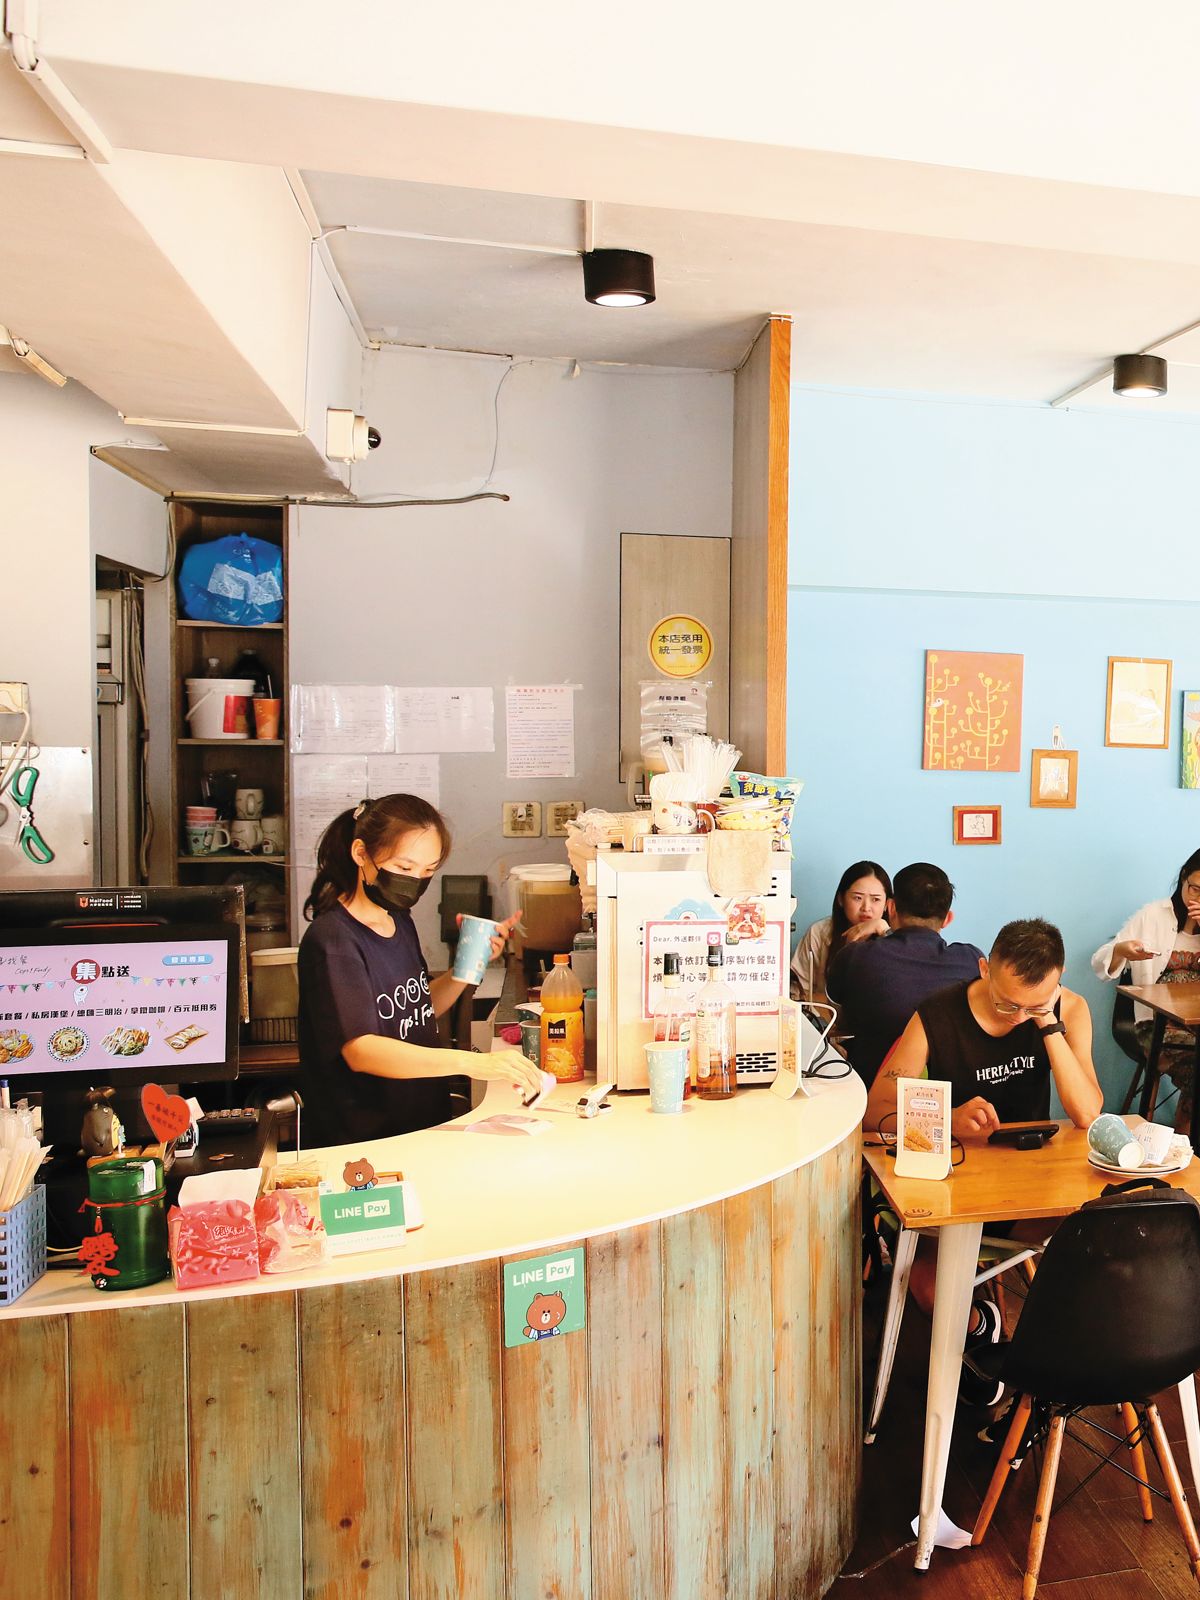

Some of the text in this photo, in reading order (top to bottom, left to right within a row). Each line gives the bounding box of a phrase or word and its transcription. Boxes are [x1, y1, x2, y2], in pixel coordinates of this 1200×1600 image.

[658, 634, 703, 643] 本店免用
[658, 645, 703, 654] 統一發票
[334, 1204, 386, 1219] LINE Pay
[513, 1265, 571, 1287] LINE Pay
